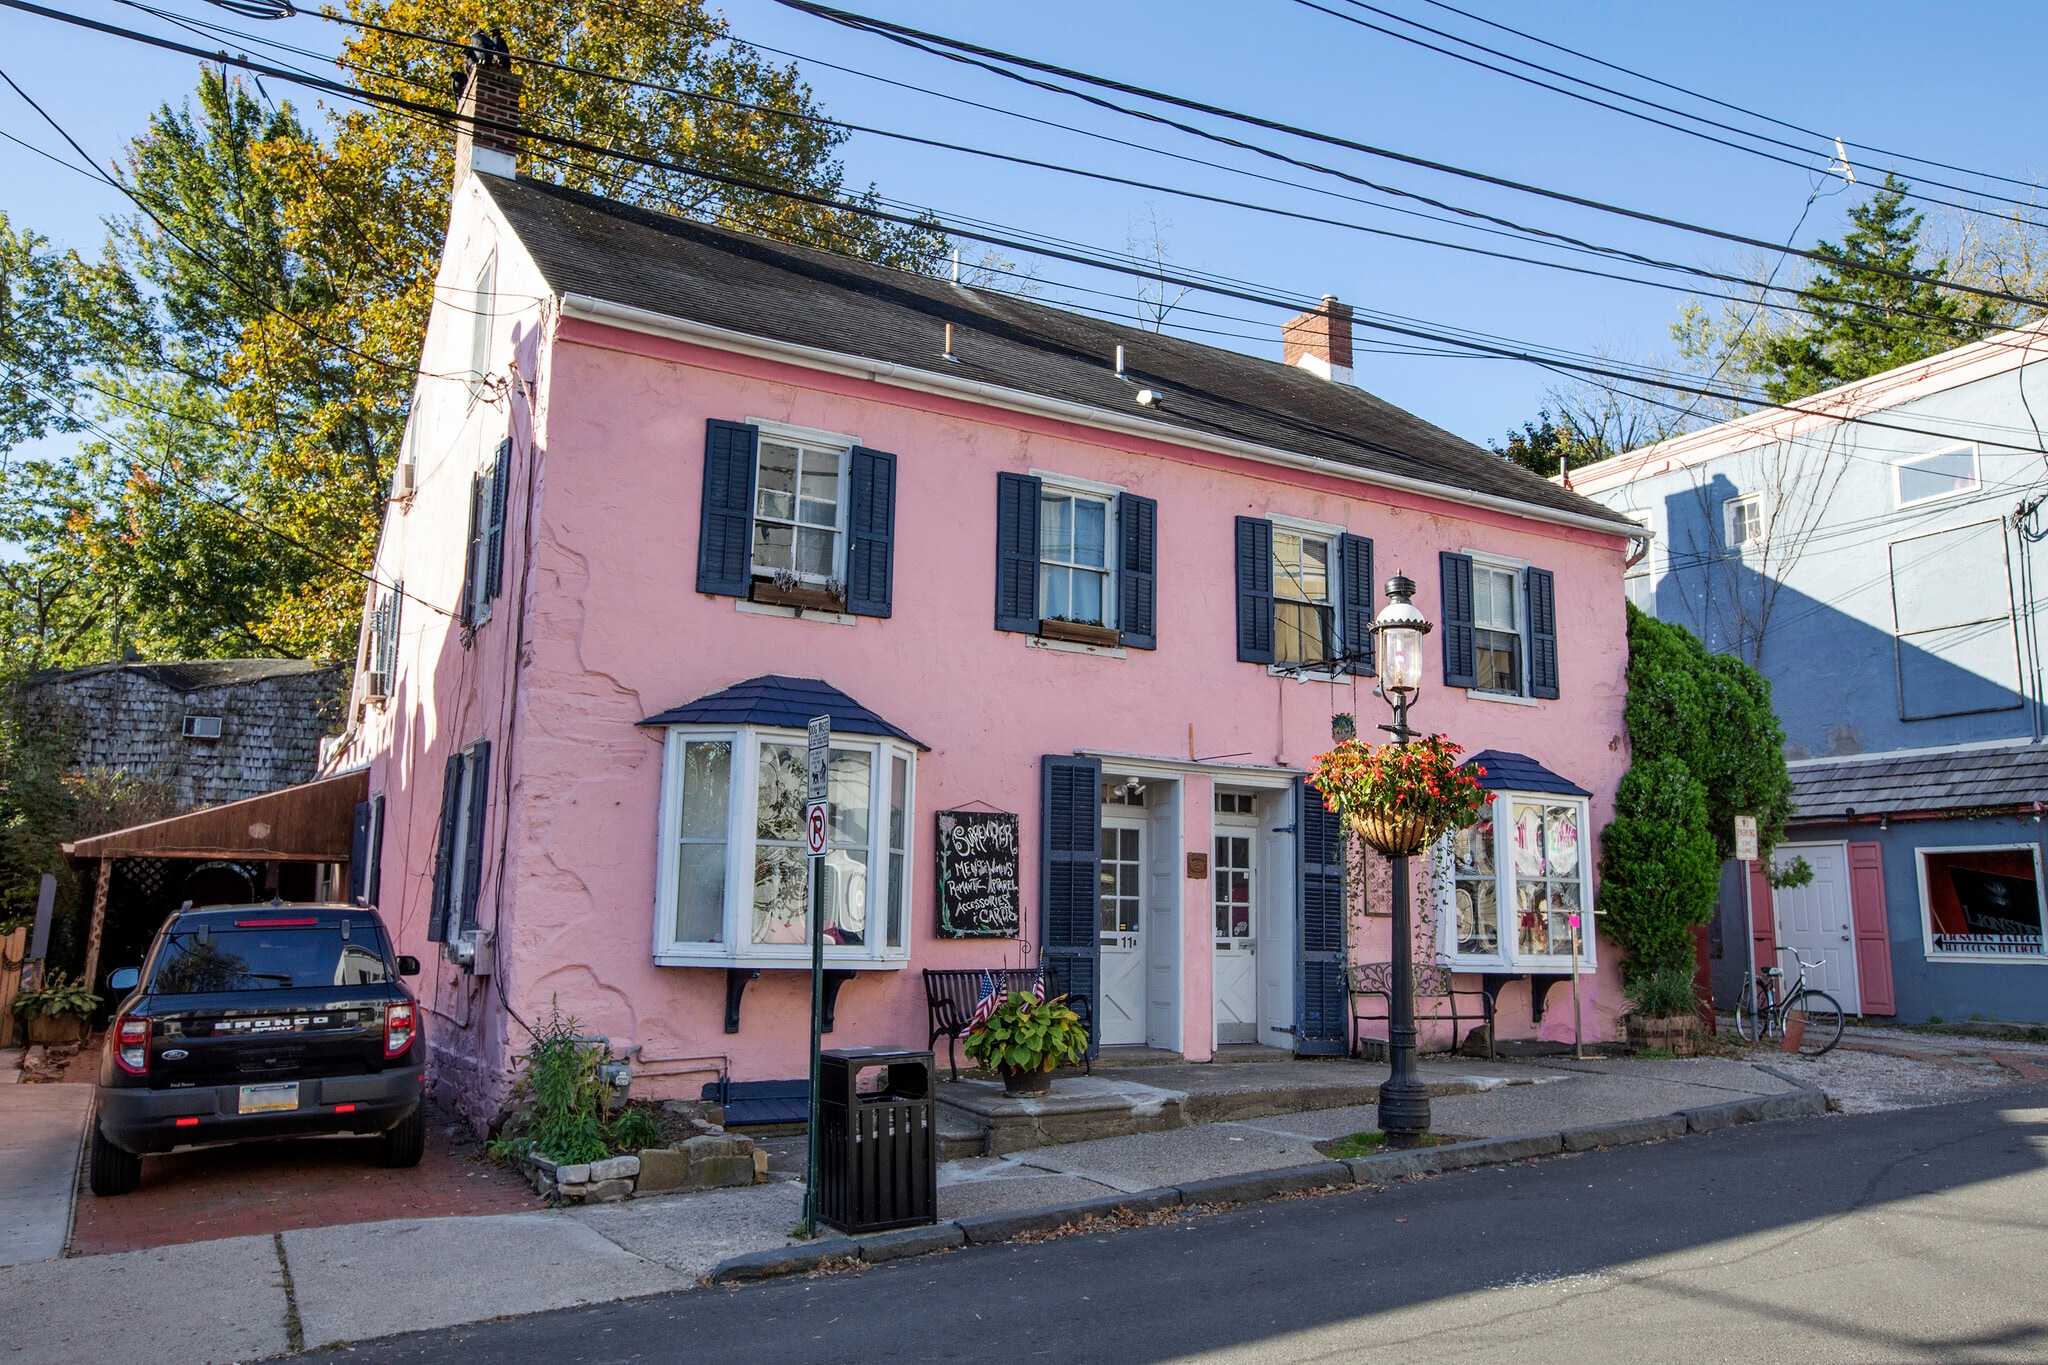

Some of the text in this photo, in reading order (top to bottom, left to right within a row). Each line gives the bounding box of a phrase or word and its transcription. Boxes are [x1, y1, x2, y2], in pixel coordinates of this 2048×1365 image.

[809, 725, 817, 735] DOG
[1741, 820, 1749, 828] NO
[1737, 828, 1755, 837] PARKING
[952, 820, 1018, 857] SURRENDER
[947, 877, 1018, 899] ROMANTIC APPAREL
[955, 894, 1011, 917] ACCESSORIES
[979, 906, 1018, 926] CARDS
[1998, 934, 2042, 943] TATTOO
[1960, 944, 1982, 952] DOOR
[1984, 944, 1996, 953] ON
[1997, 945, 2012, 953] THE
[2015, 945, 2041, 954] RIGHT
[214, 1016, 329, 1030] BRONCO
[251, 1025, 293, 1033] SPORT
